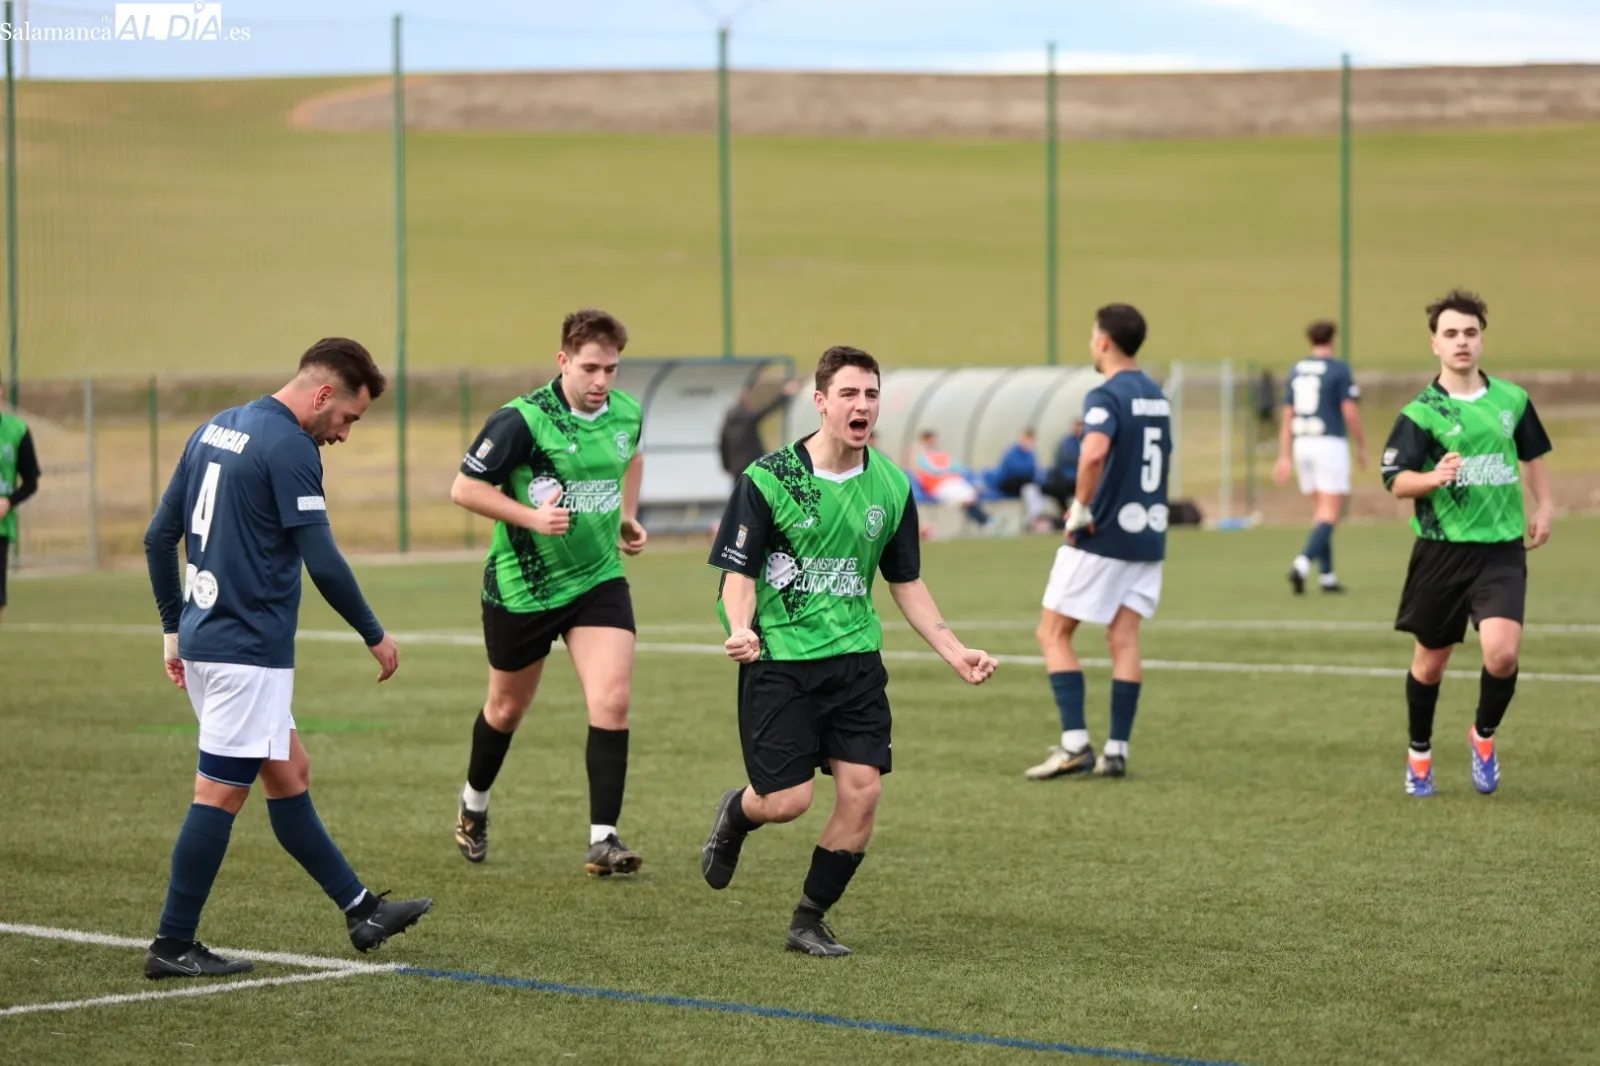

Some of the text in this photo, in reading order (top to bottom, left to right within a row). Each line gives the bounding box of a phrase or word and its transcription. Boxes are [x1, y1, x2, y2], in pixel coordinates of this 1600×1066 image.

[1140, 426, 1163, 493] 5
[191, 461, 222, 553] 4
[793, 573, 868, 595] EUROTORMS
[801, 557, 858, 572] TRANSPORES
